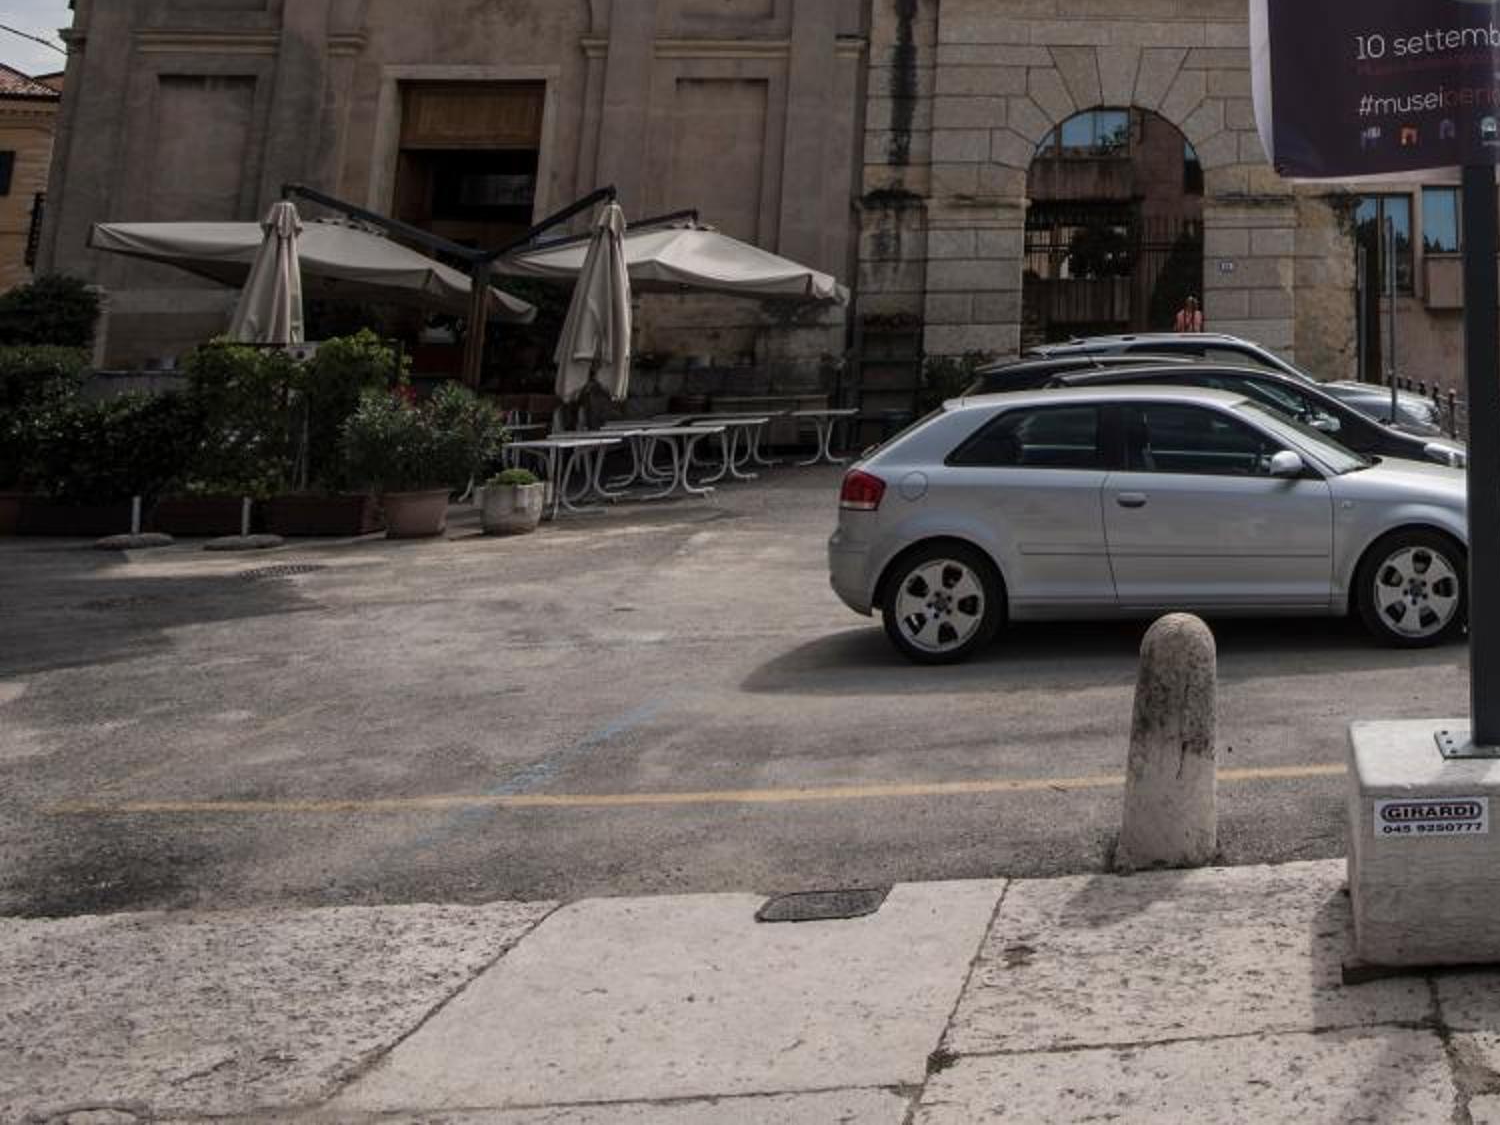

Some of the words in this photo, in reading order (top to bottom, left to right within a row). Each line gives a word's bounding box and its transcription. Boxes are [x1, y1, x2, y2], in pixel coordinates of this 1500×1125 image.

[1355, 34, 1386, 60] 10
[1388, 806, 1474, 818] GIRARDI
[1383, 824, 1411, 834] 045
